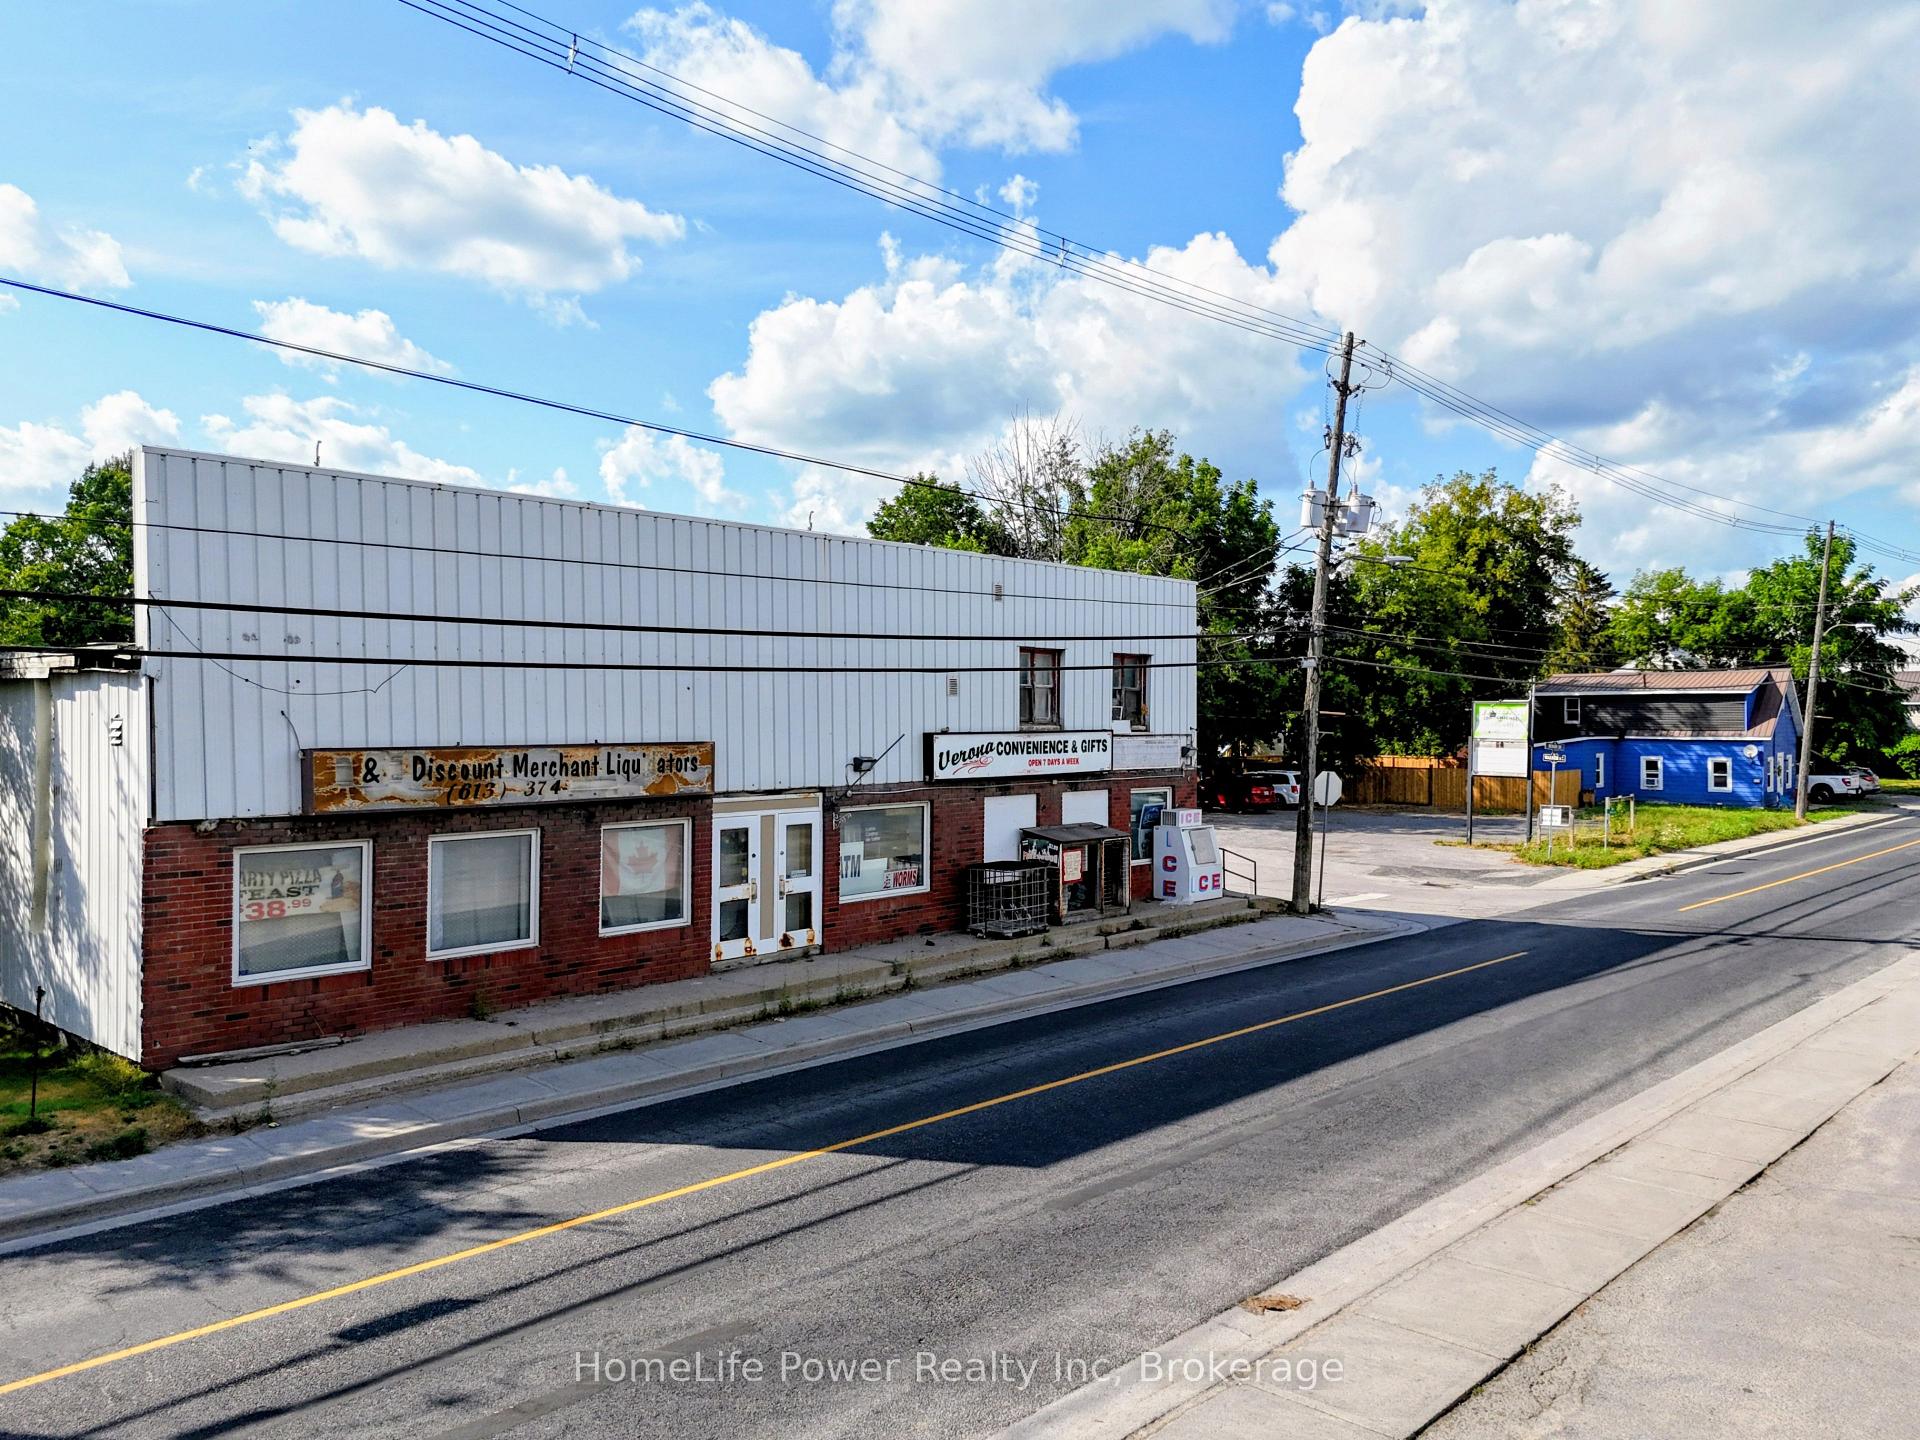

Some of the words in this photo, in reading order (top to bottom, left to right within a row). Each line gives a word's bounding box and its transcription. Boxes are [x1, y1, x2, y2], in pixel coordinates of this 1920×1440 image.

[938, 741, 995, 771] Verona
[996, 740, 1069, 756] CONVENIENCE
[1071, 740, 1078, 754] &
[1081, 739, 1108, 753] GIFTS
[1028, 759, 1042, 767] OPEN
[1047, 758, 1061, 766] DAYS
[1066, 757, 1080, 765] WEEK
[363, 757, 380, 784] &
[413, 755, 504, 782] Discount
[513, 751, 599, 778] Merchant
[447, 782, 506, 805] (613)
[1181, 812, 1201, 824] ICE
[281, 868, 322, 885] PIZZA
[893, 868, 917, 888] WORMS
